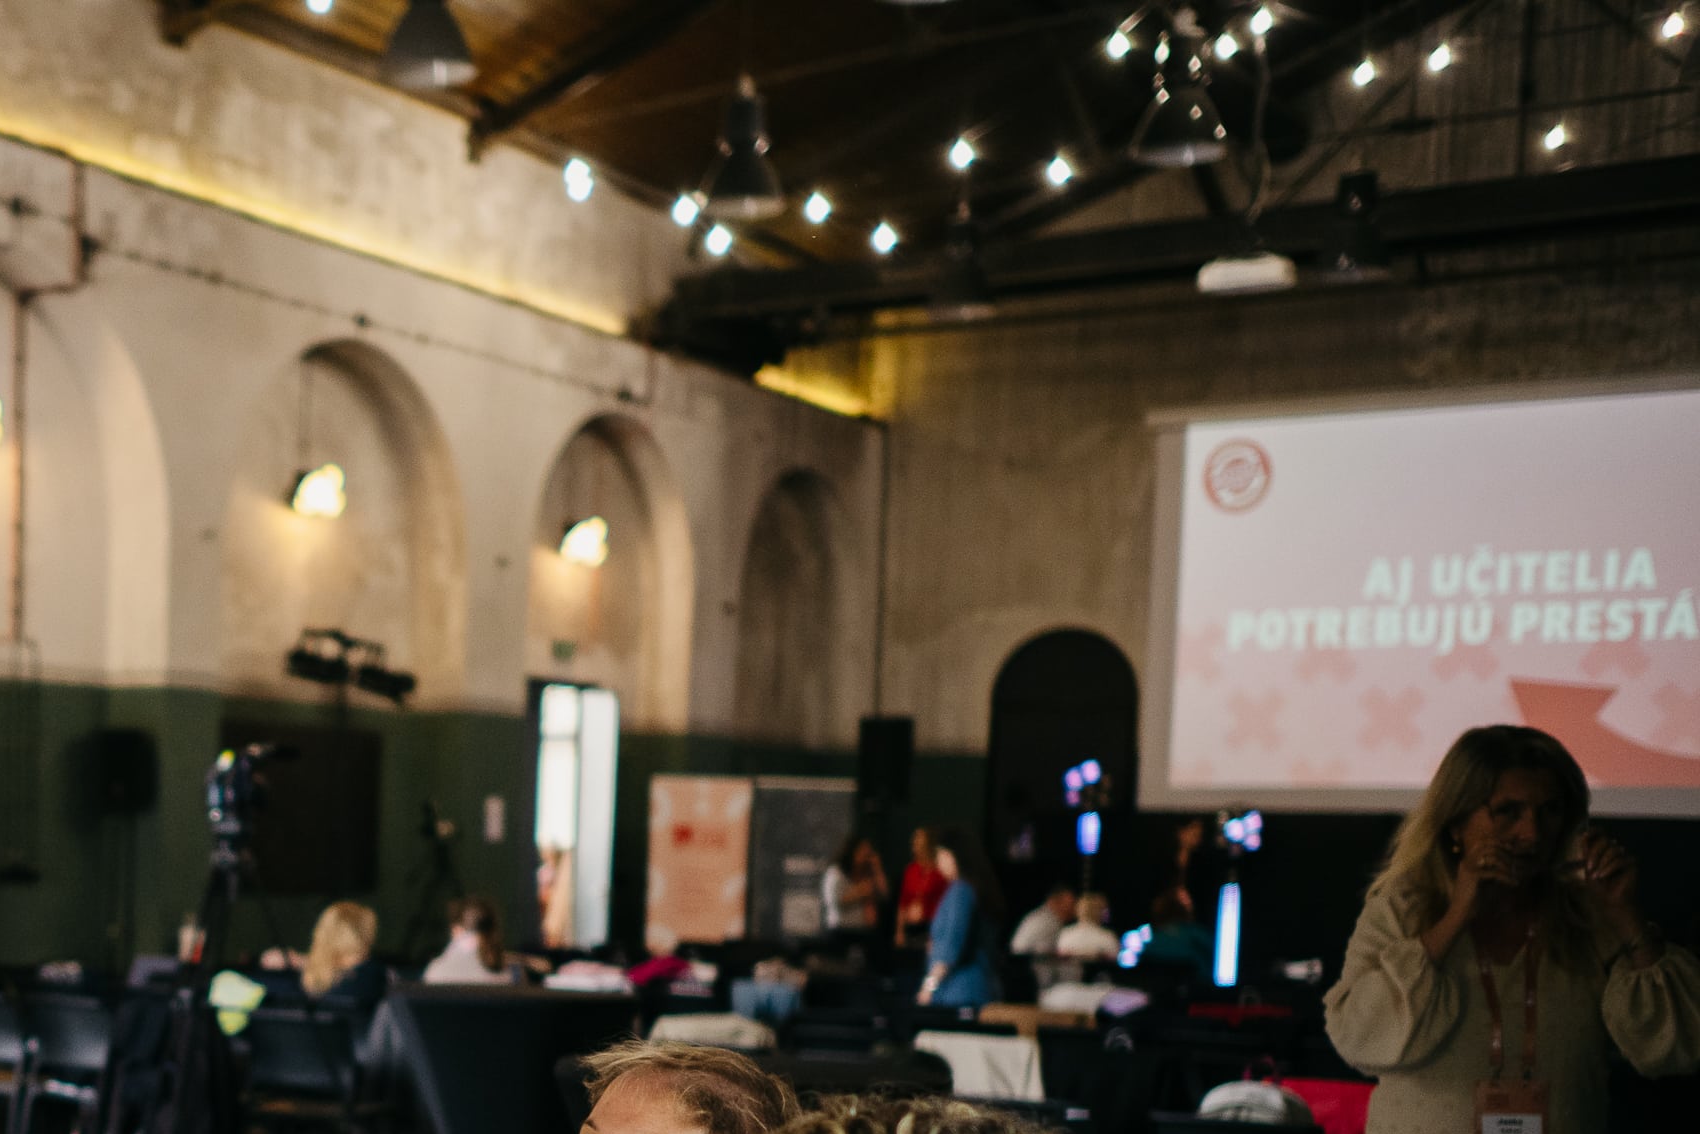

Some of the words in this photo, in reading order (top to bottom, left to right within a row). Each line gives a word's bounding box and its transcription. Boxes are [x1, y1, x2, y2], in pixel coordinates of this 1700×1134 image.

[1363, 555, 1413, 604] AJ
[1431, 545, 1657, 597] UČITELIA
[1228, 595, 1493, 655] POTREBUJÚ
